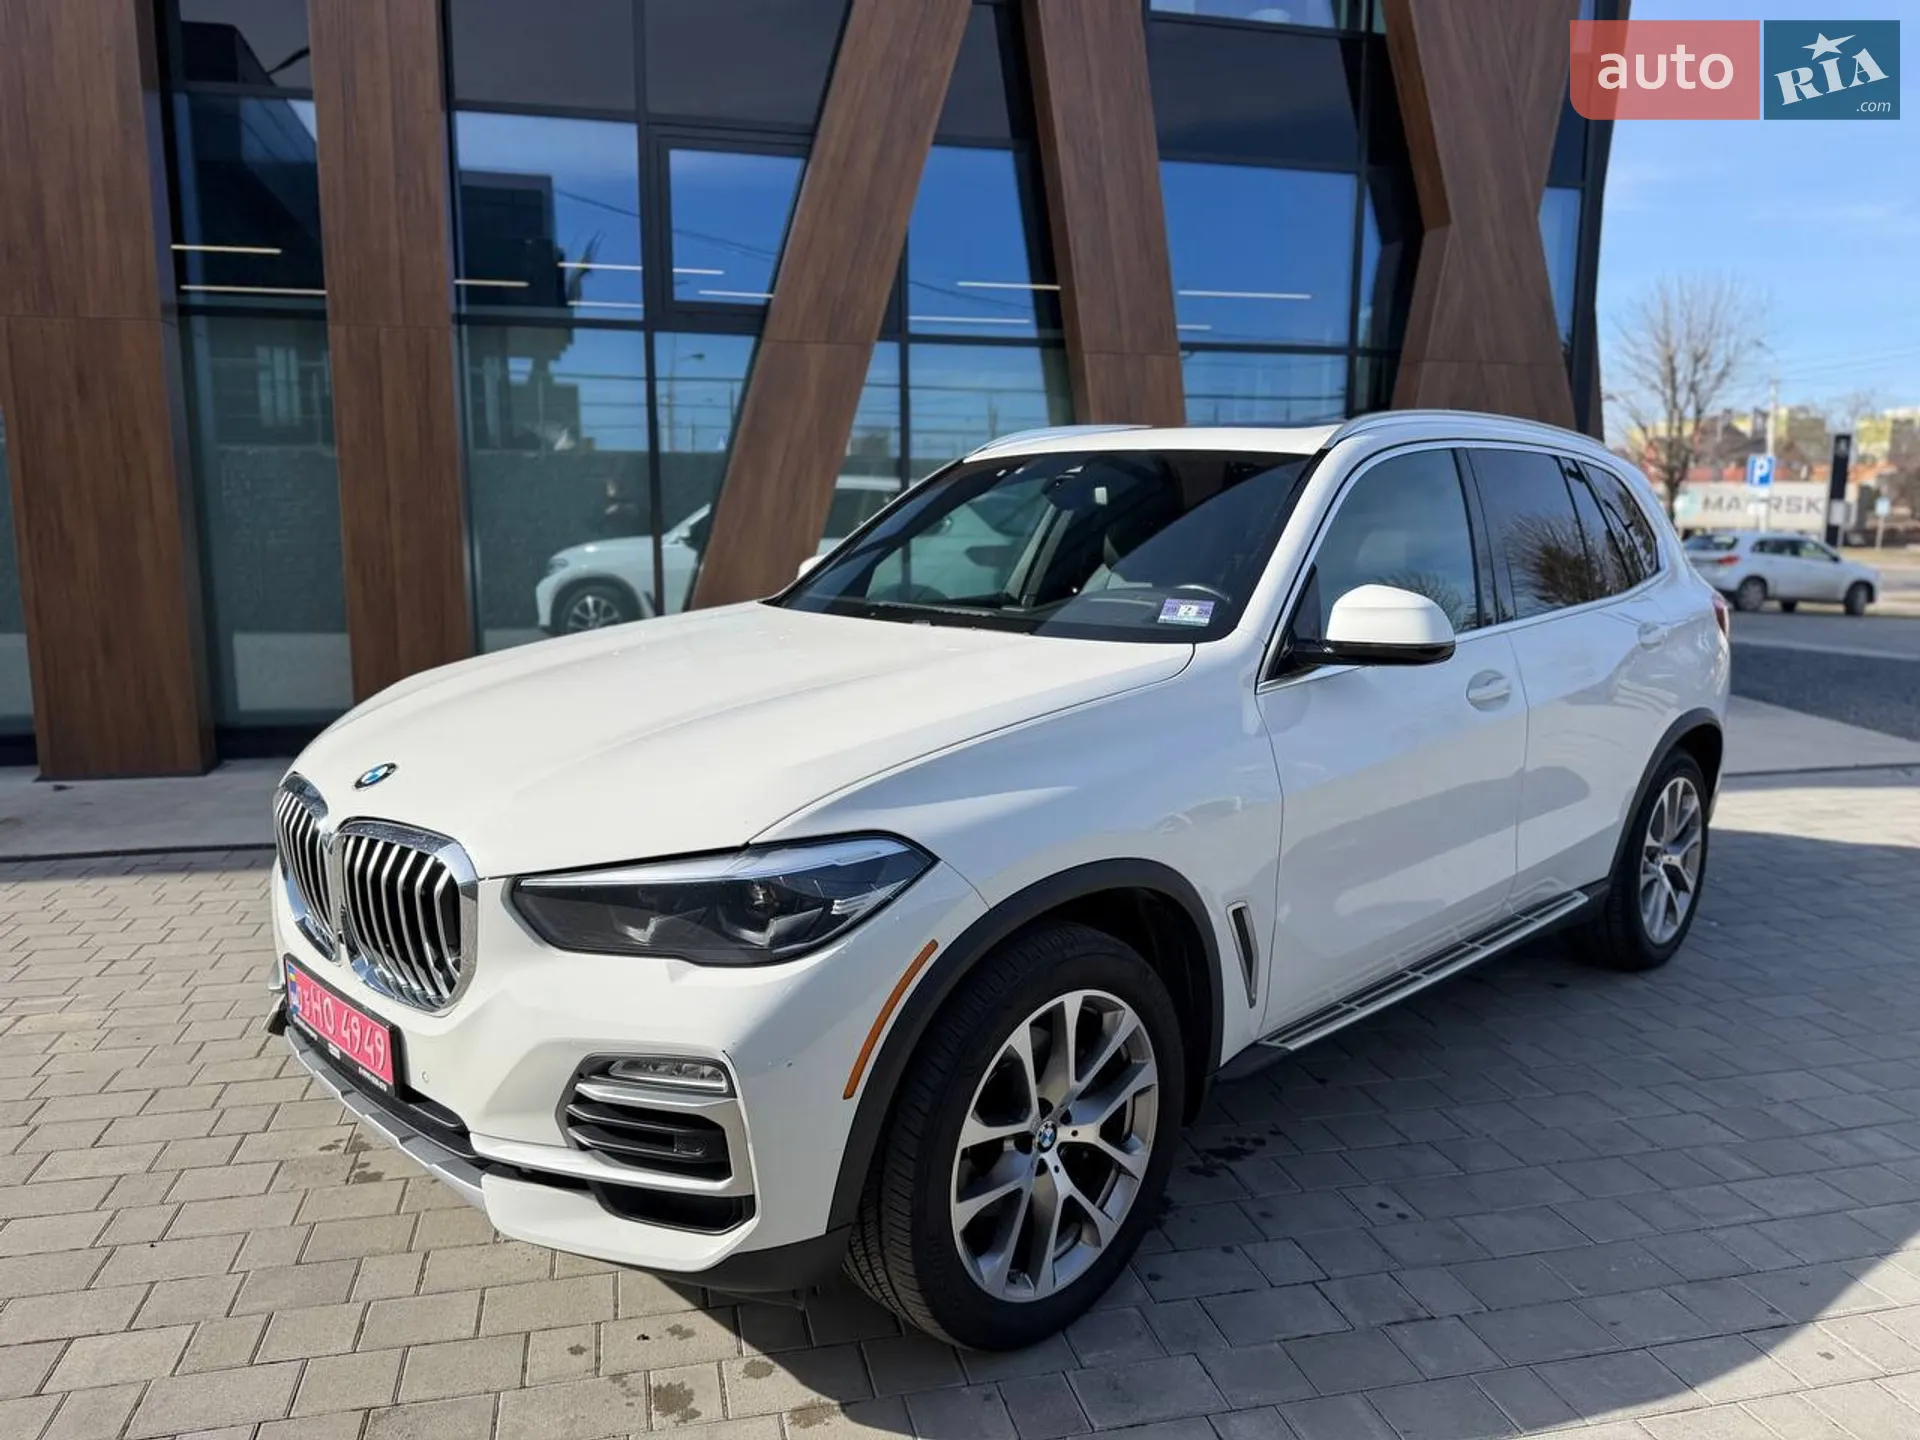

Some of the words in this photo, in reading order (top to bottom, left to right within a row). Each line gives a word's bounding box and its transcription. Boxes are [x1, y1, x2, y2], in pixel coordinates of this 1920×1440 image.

[1752, 457, 1770, 485] P
[1702, 494, 1823, 516] MARSK
[341, 1010, 386, 1071] 4949
